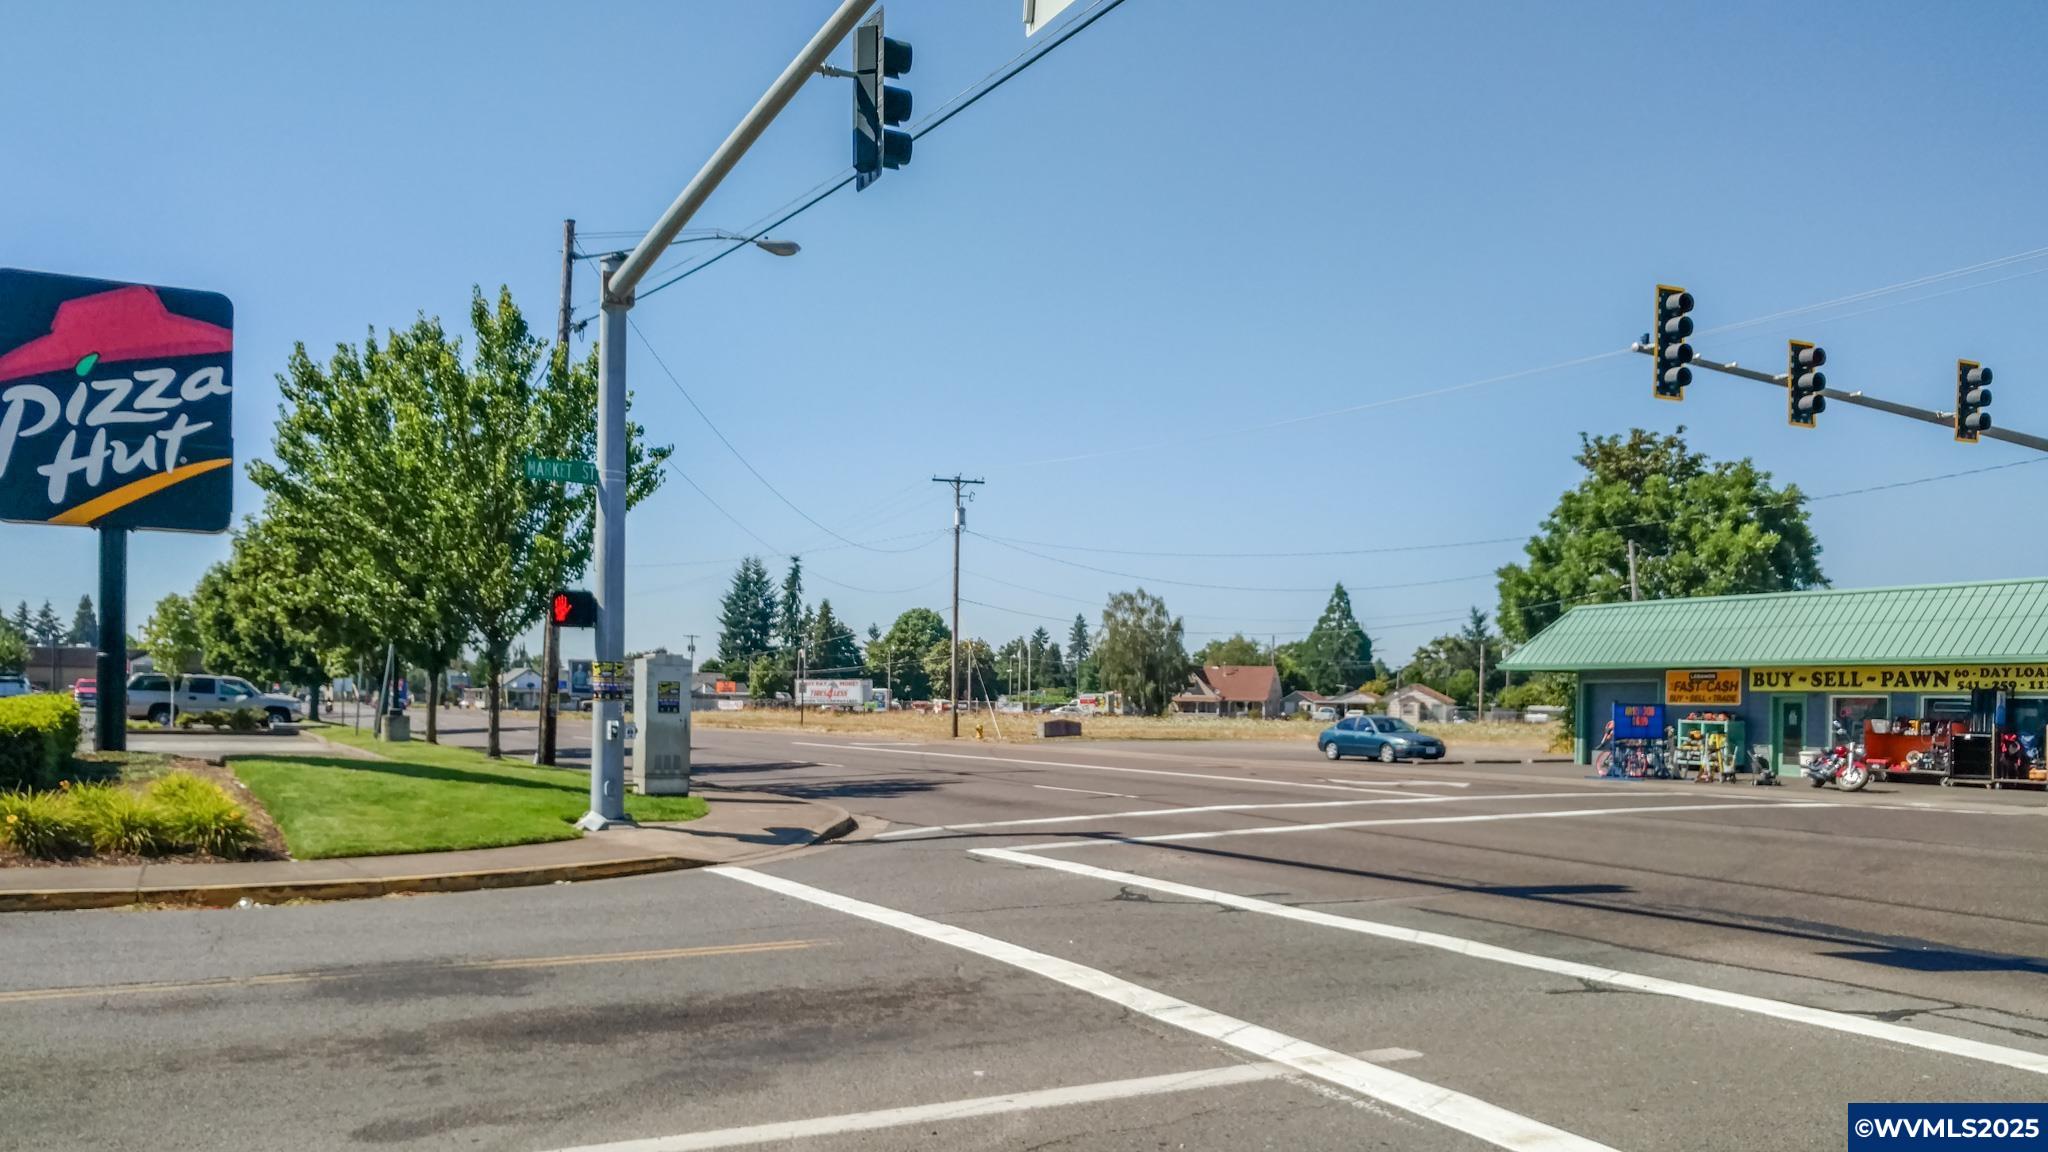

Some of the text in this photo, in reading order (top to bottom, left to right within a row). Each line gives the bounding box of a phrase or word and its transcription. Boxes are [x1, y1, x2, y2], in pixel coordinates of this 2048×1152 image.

[0, 353, 233, 479] Pizza
[37, 413, 213, 504] Hut
[527, 460, 596, 480] MARKET ST
[1752, 671, 1794, 687] BUY
[1811, 671, 1863, 687] SELL
[1881, 670, 1950, 687] PAWN
[1954, 668, 1970, 678] 60
[1980, 667, 2011, 678] DAY
[2015, 667, 2048, 678] LOA
[1674, 680, 1739, 692] FAST CASH
[2029, 681, 2048, 690] 11
[1669, 695, 1683, 703] BUY
